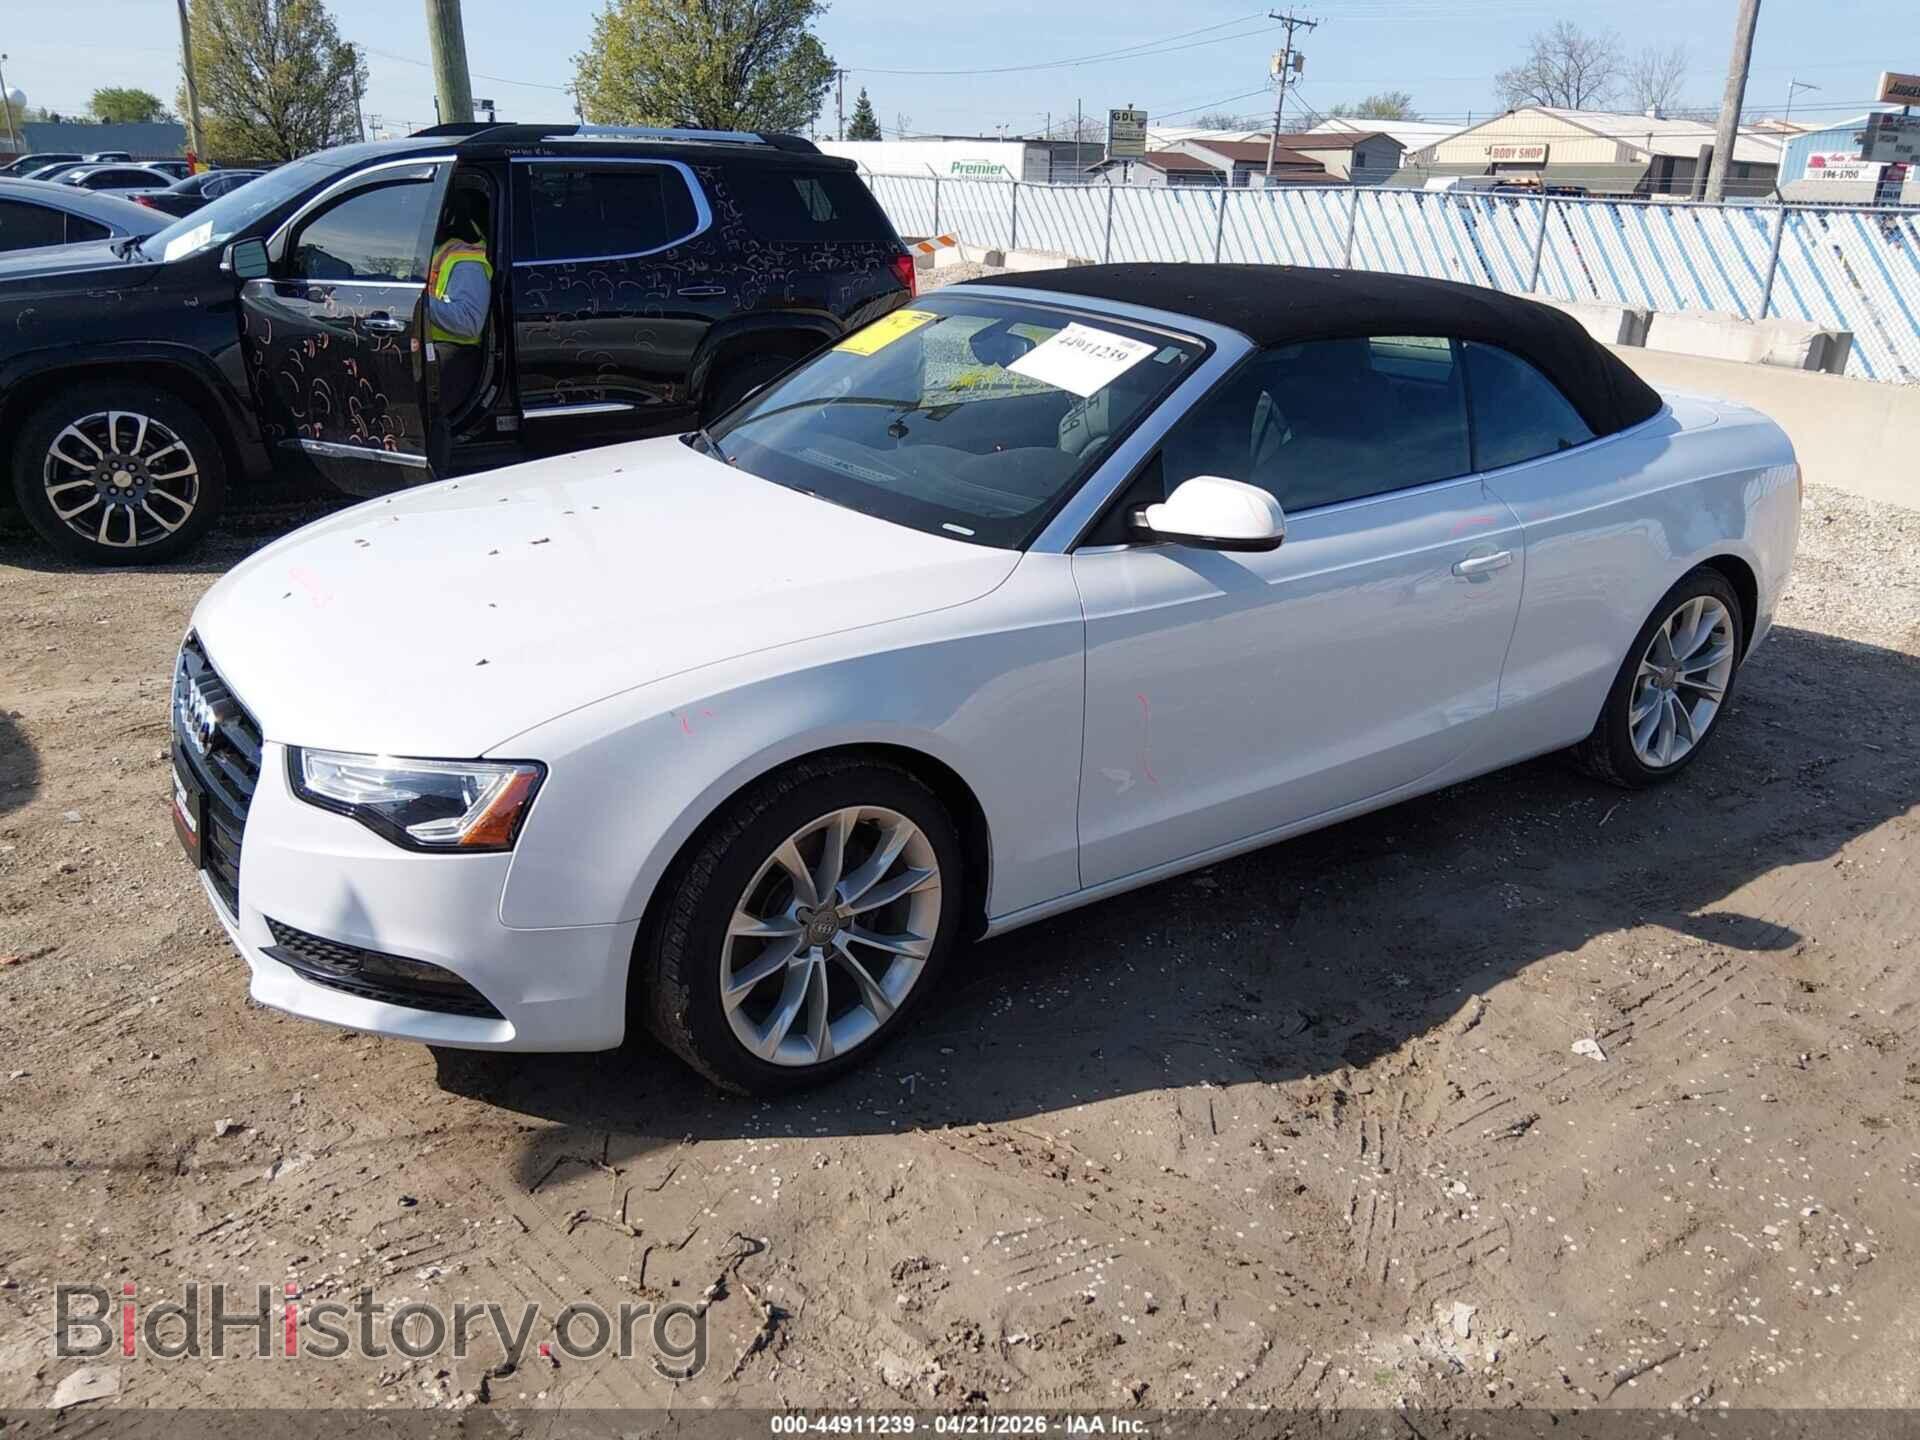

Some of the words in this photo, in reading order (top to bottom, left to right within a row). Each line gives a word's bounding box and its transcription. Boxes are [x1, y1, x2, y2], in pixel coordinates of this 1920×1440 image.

[1112, 112, 1136, 121] GDL
[1494, 148, 1517, 159] BODY
[1518, 148, 1543, 159] SHOP
[951, 161, 1003, 175] Premier
